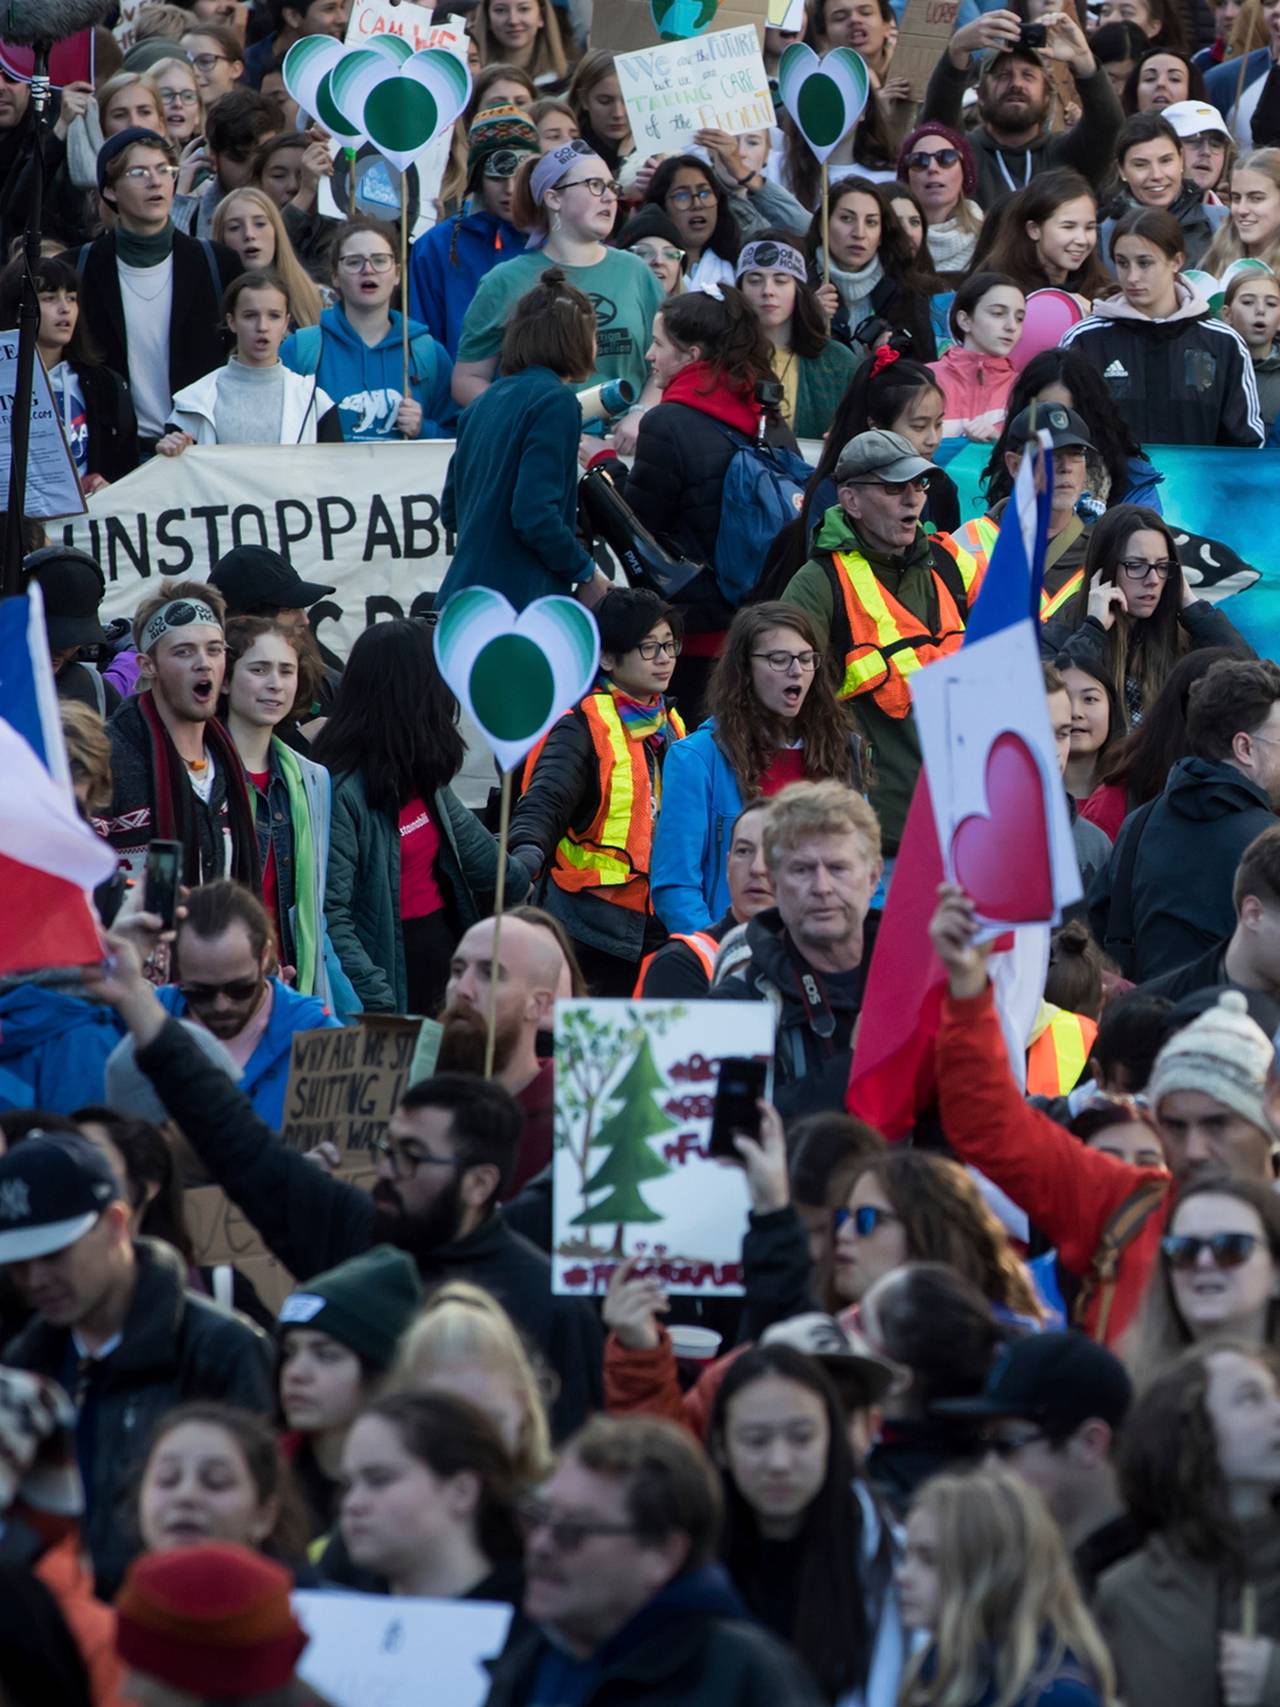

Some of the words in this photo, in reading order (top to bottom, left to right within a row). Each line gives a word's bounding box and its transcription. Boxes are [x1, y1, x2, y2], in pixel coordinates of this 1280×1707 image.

[618, 51, 672, 83] We
[705, 29, 761, 62] FUTURE
[627, 84, 713, 114] TAKING
[720, 66, 760, 99] CARE
[644, 112, 662, 141] of
[669, 112, 694, 132] the
[802, 974, 821, 1006] EOS
[362, 1030, 388, 1068] WE
[347, 1119, 391, 1152] WAT
